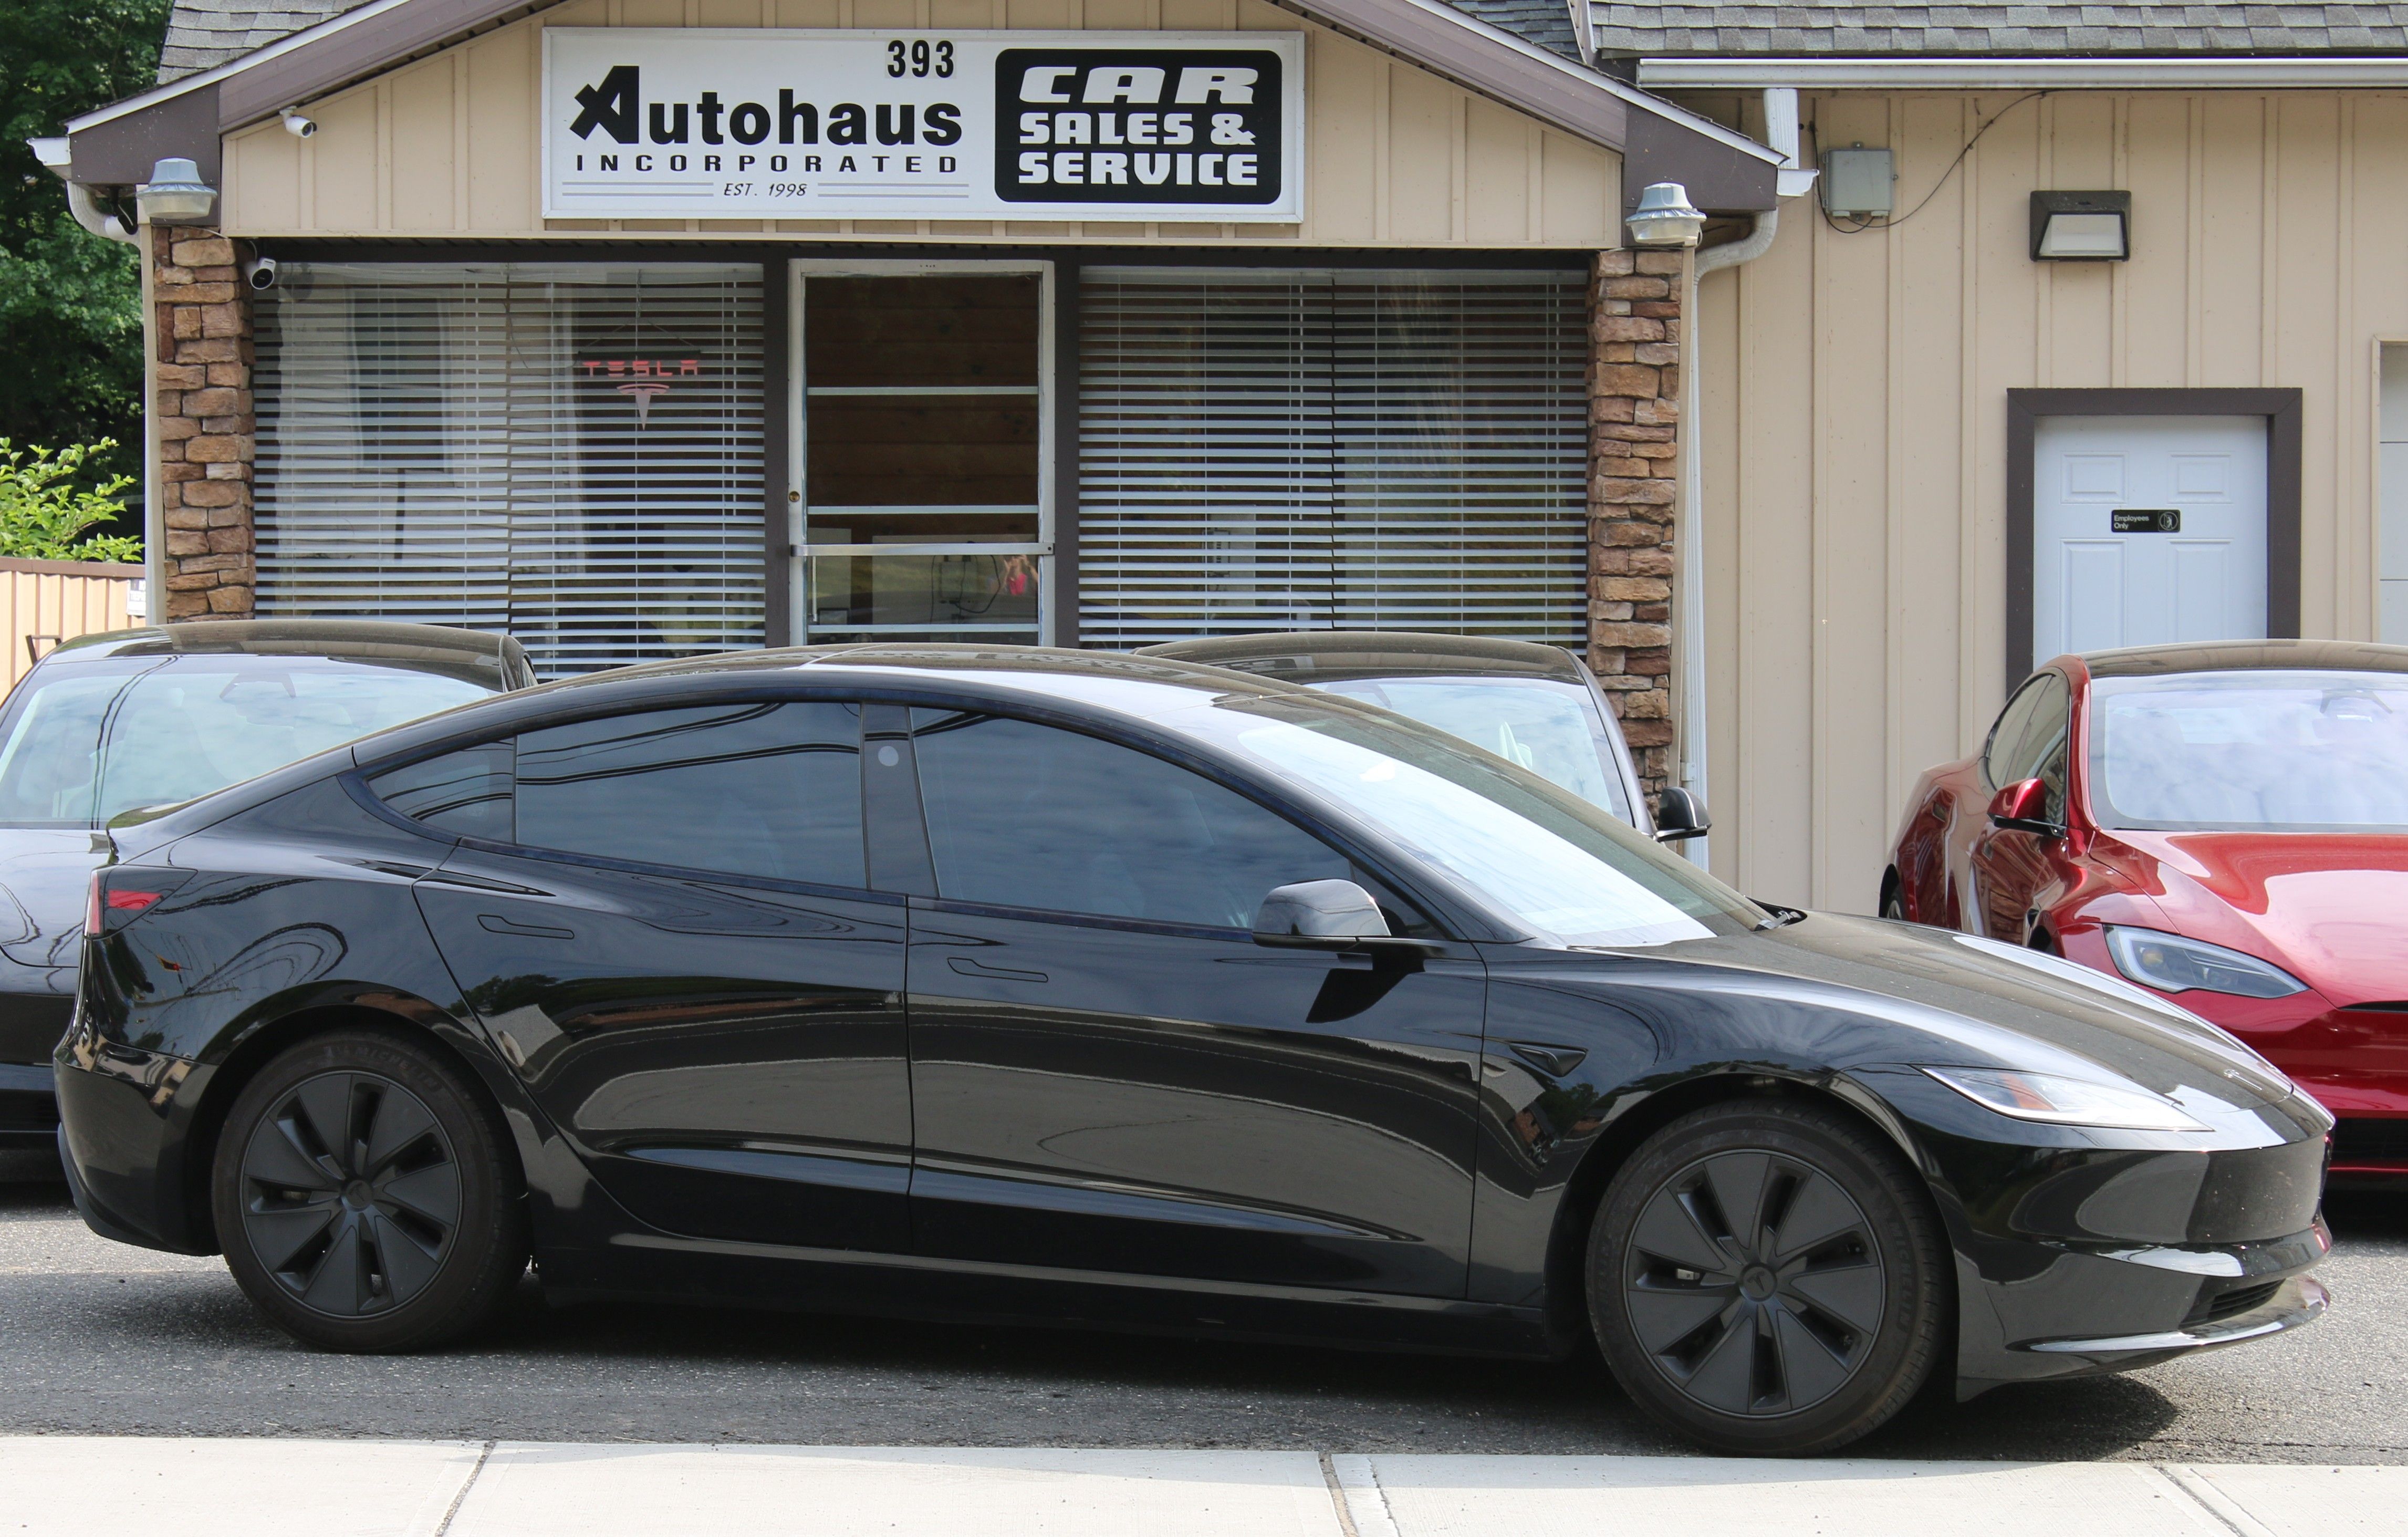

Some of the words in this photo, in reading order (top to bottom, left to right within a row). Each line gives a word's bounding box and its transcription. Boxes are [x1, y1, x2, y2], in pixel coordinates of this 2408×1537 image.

[888, 40, 954, 78] 393
[1019, 66, 1258, 104] CAR
[569, 66, 962, 146] Autohaus
[1019, 112, 1193, 145] SALES
[1210, 113, 1256, 145] &
[577, 154, 956, 173] INCORPORATED
[1018, 152, 1258, 186] SERVICE
[724, 183, 757, 196] EST.
[769, 183, 807, 198] 1998
[583, 360, 697, 377] TESLA
[357, 1045, 440, 1089] MICHELIN
[1888, 1221, 1913, 1327] MICHELIN
